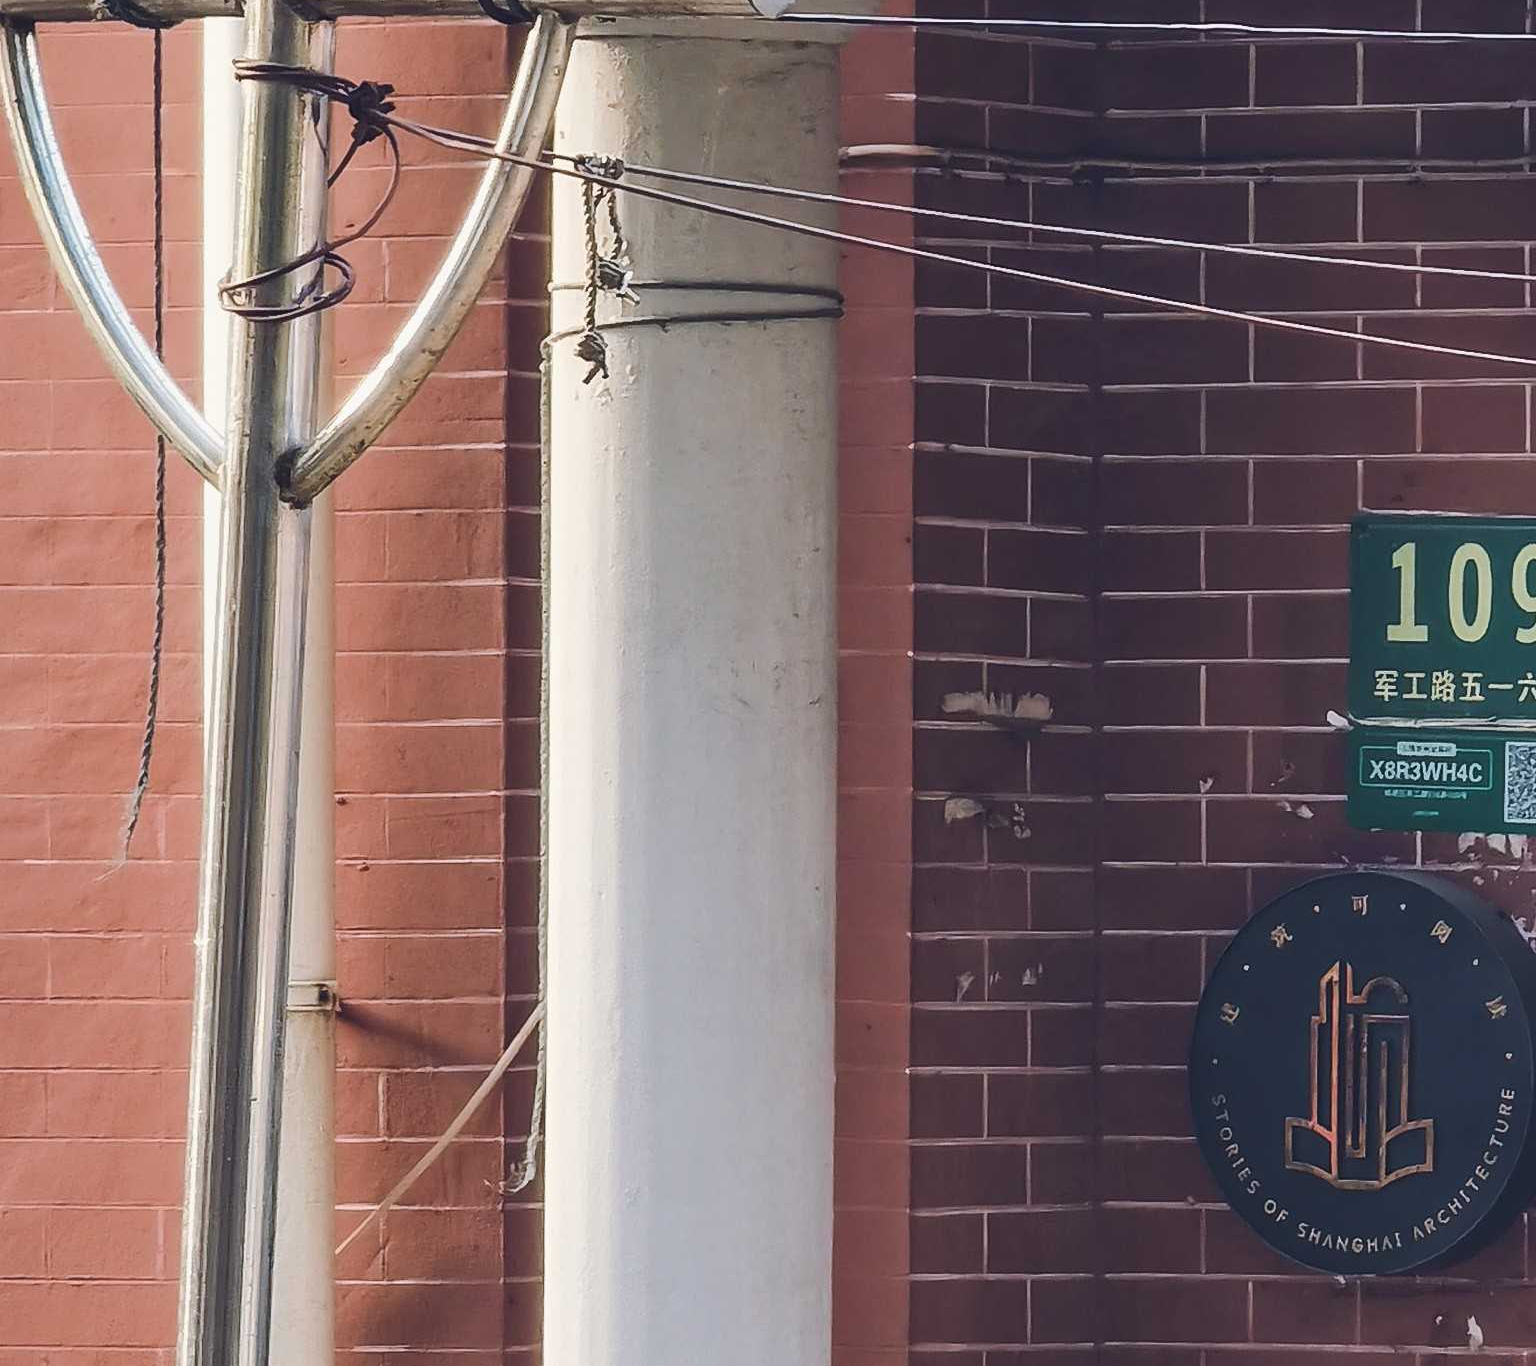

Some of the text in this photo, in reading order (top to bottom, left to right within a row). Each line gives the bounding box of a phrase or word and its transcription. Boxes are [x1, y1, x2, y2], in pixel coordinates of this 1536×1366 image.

[1369, 759, 1483, 783] X8R3WH4C
[1211, 1088, 1516, 1254] STORIES OF SHANGHAI ARCHITECTURE
